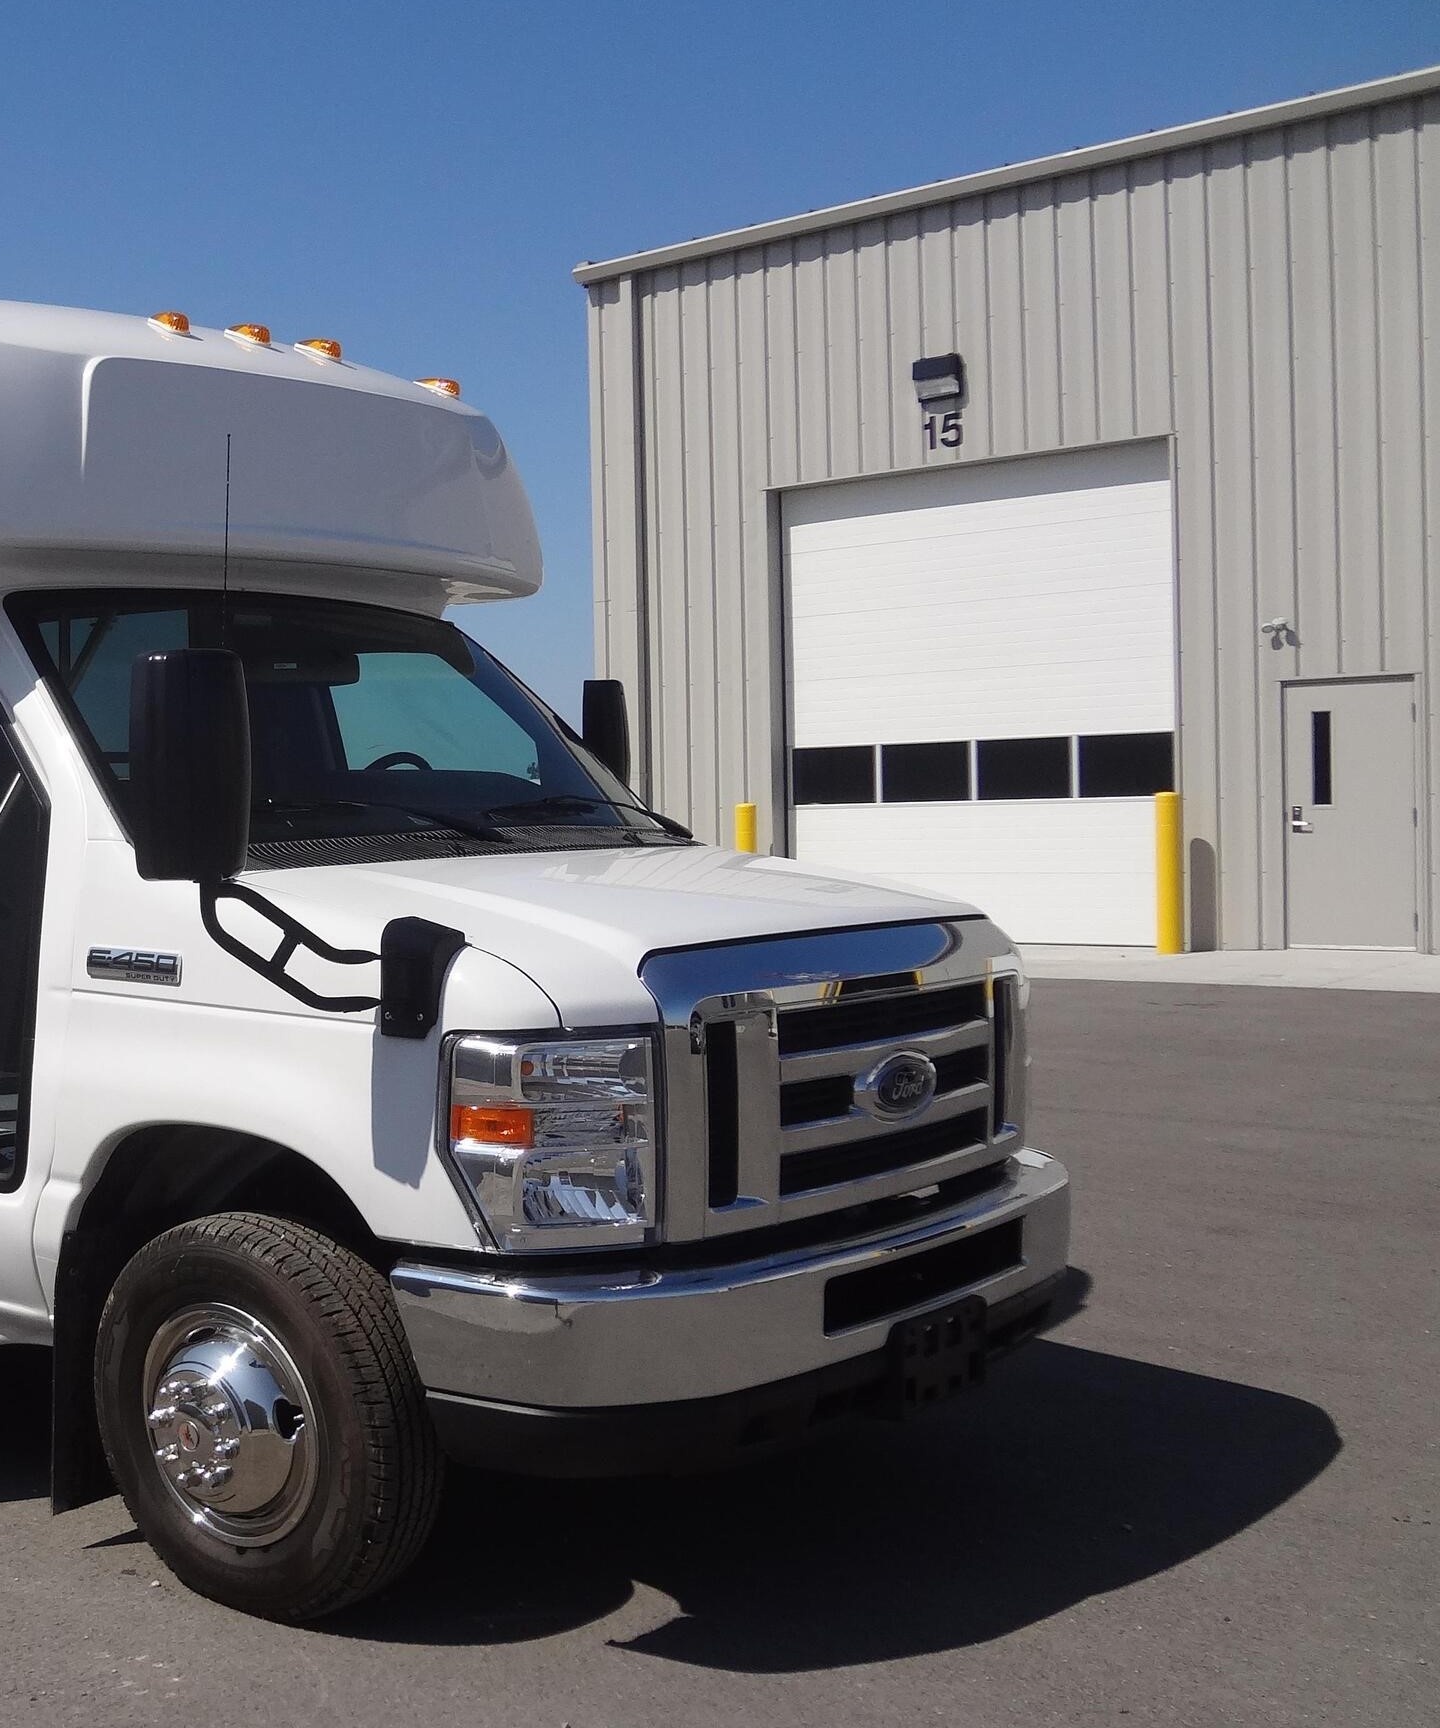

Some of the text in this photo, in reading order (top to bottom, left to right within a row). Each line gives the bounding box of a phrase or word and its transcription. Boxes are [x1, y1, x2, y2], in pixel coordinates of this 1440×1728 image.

[923, 412, 964, 450] 15
[87, 948, 179, 975] E-450
[125, 972, 176, 983] SUPER DUTY
[891, 1071, 925, 1100] Ford
